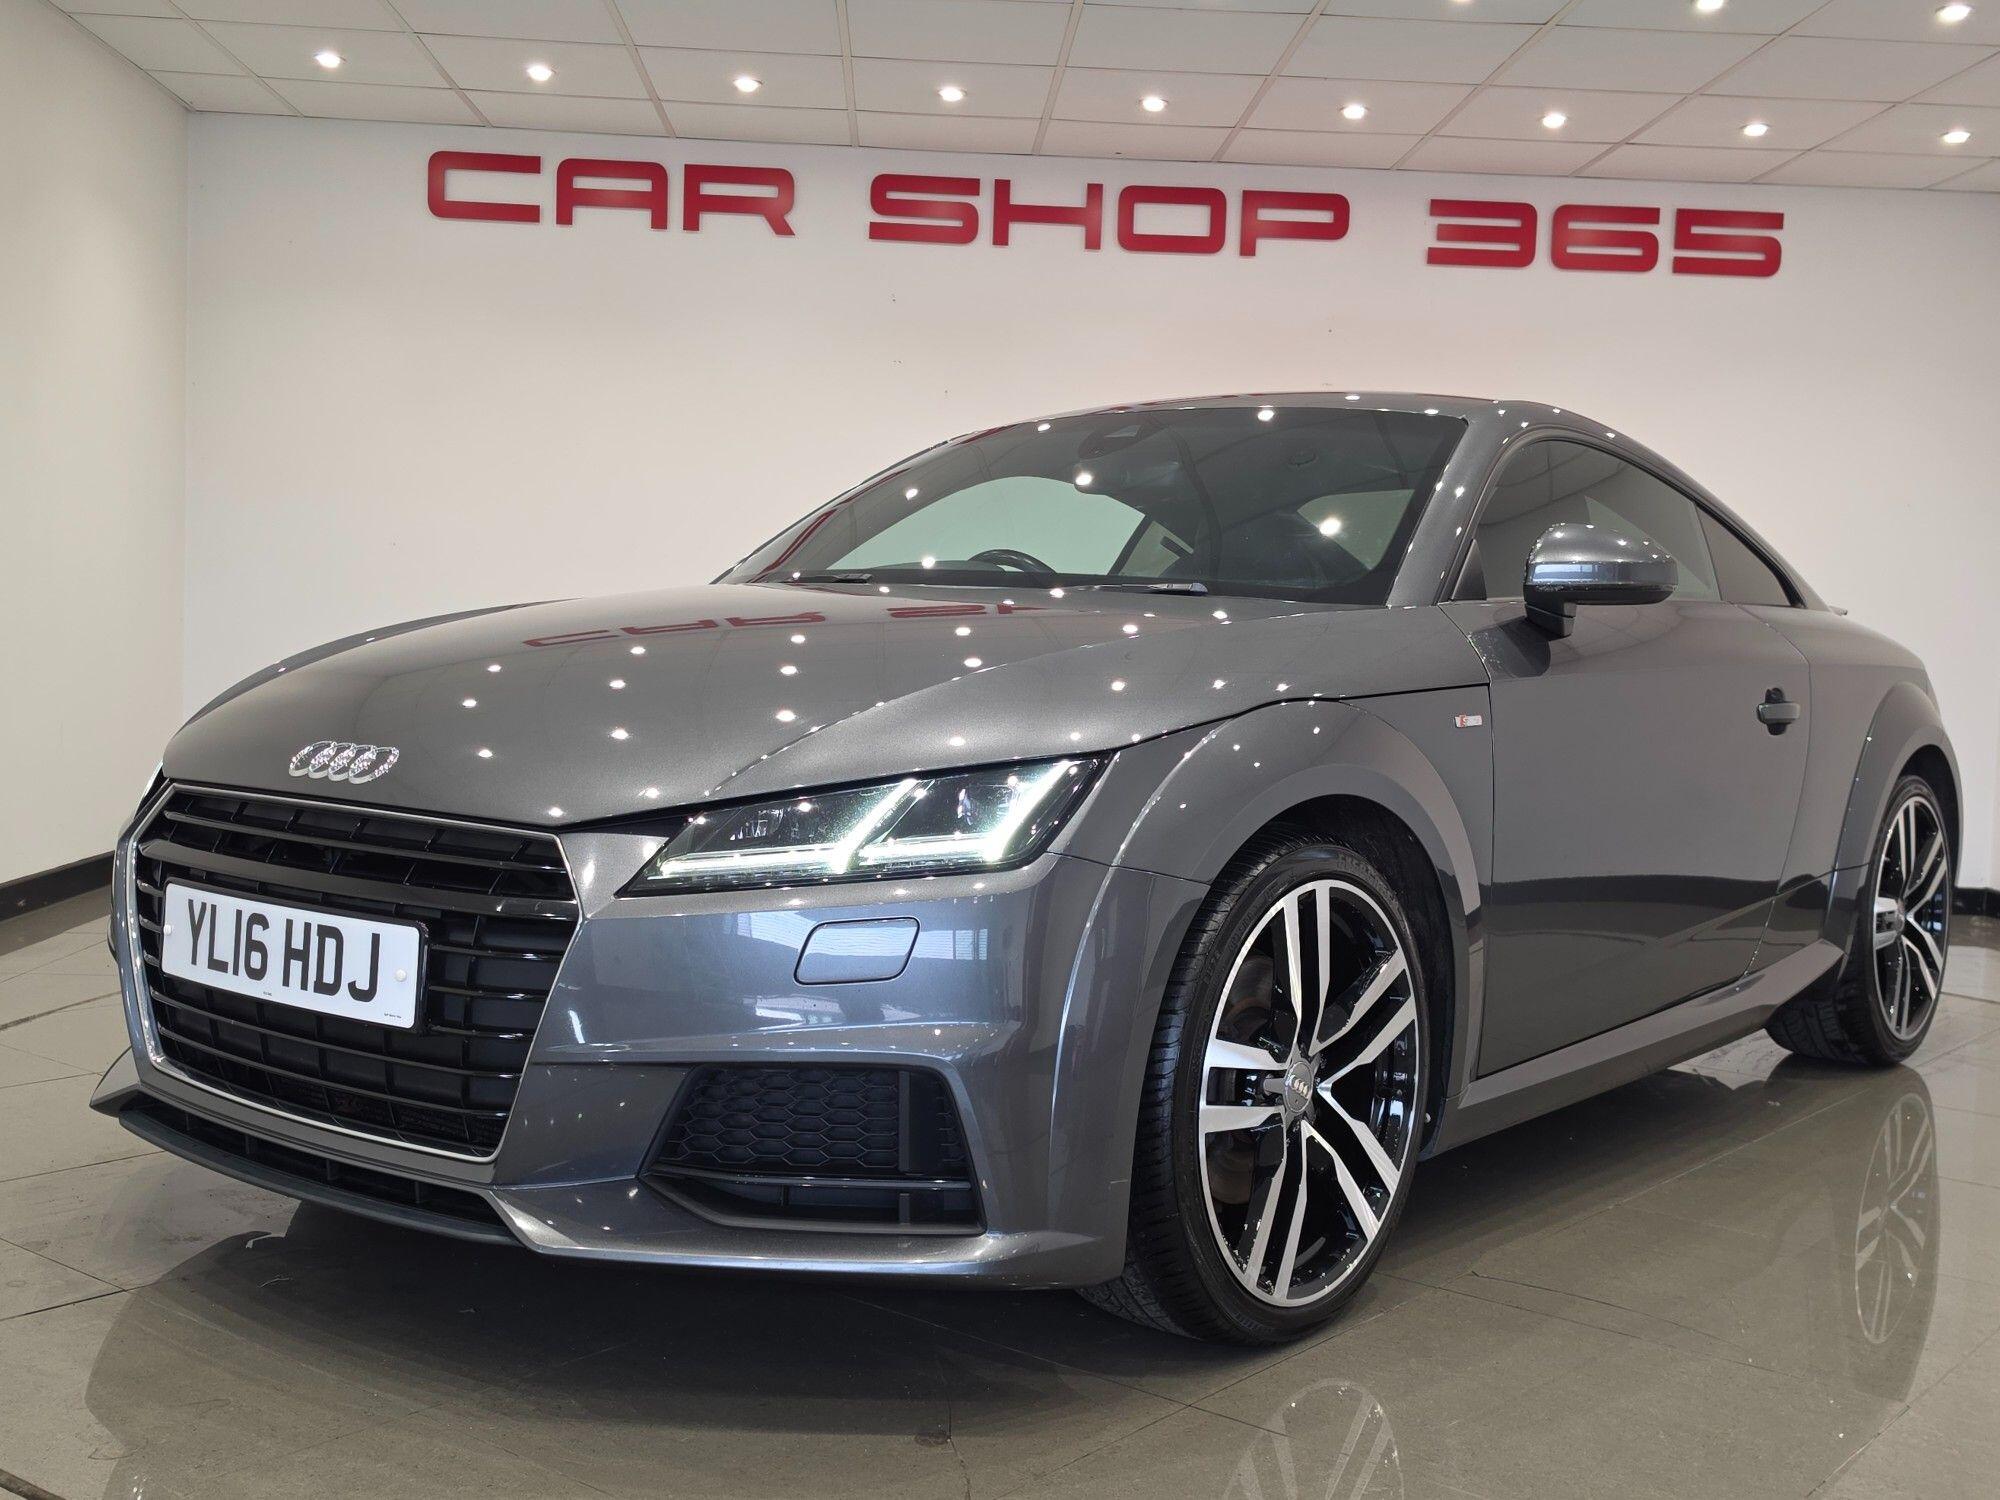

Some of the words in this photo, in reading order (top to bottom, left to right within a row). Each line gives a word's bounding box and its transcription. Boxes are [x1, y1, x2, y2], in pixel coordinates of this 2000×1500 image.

[427, 150, 796, 237] CAR
[868, 173, 1351, 257] SHOP
[1426, 198, 1785, 278] 365
[187, 898, 270, 982] YL16
[281, 918, 381, 1003] HDJ
